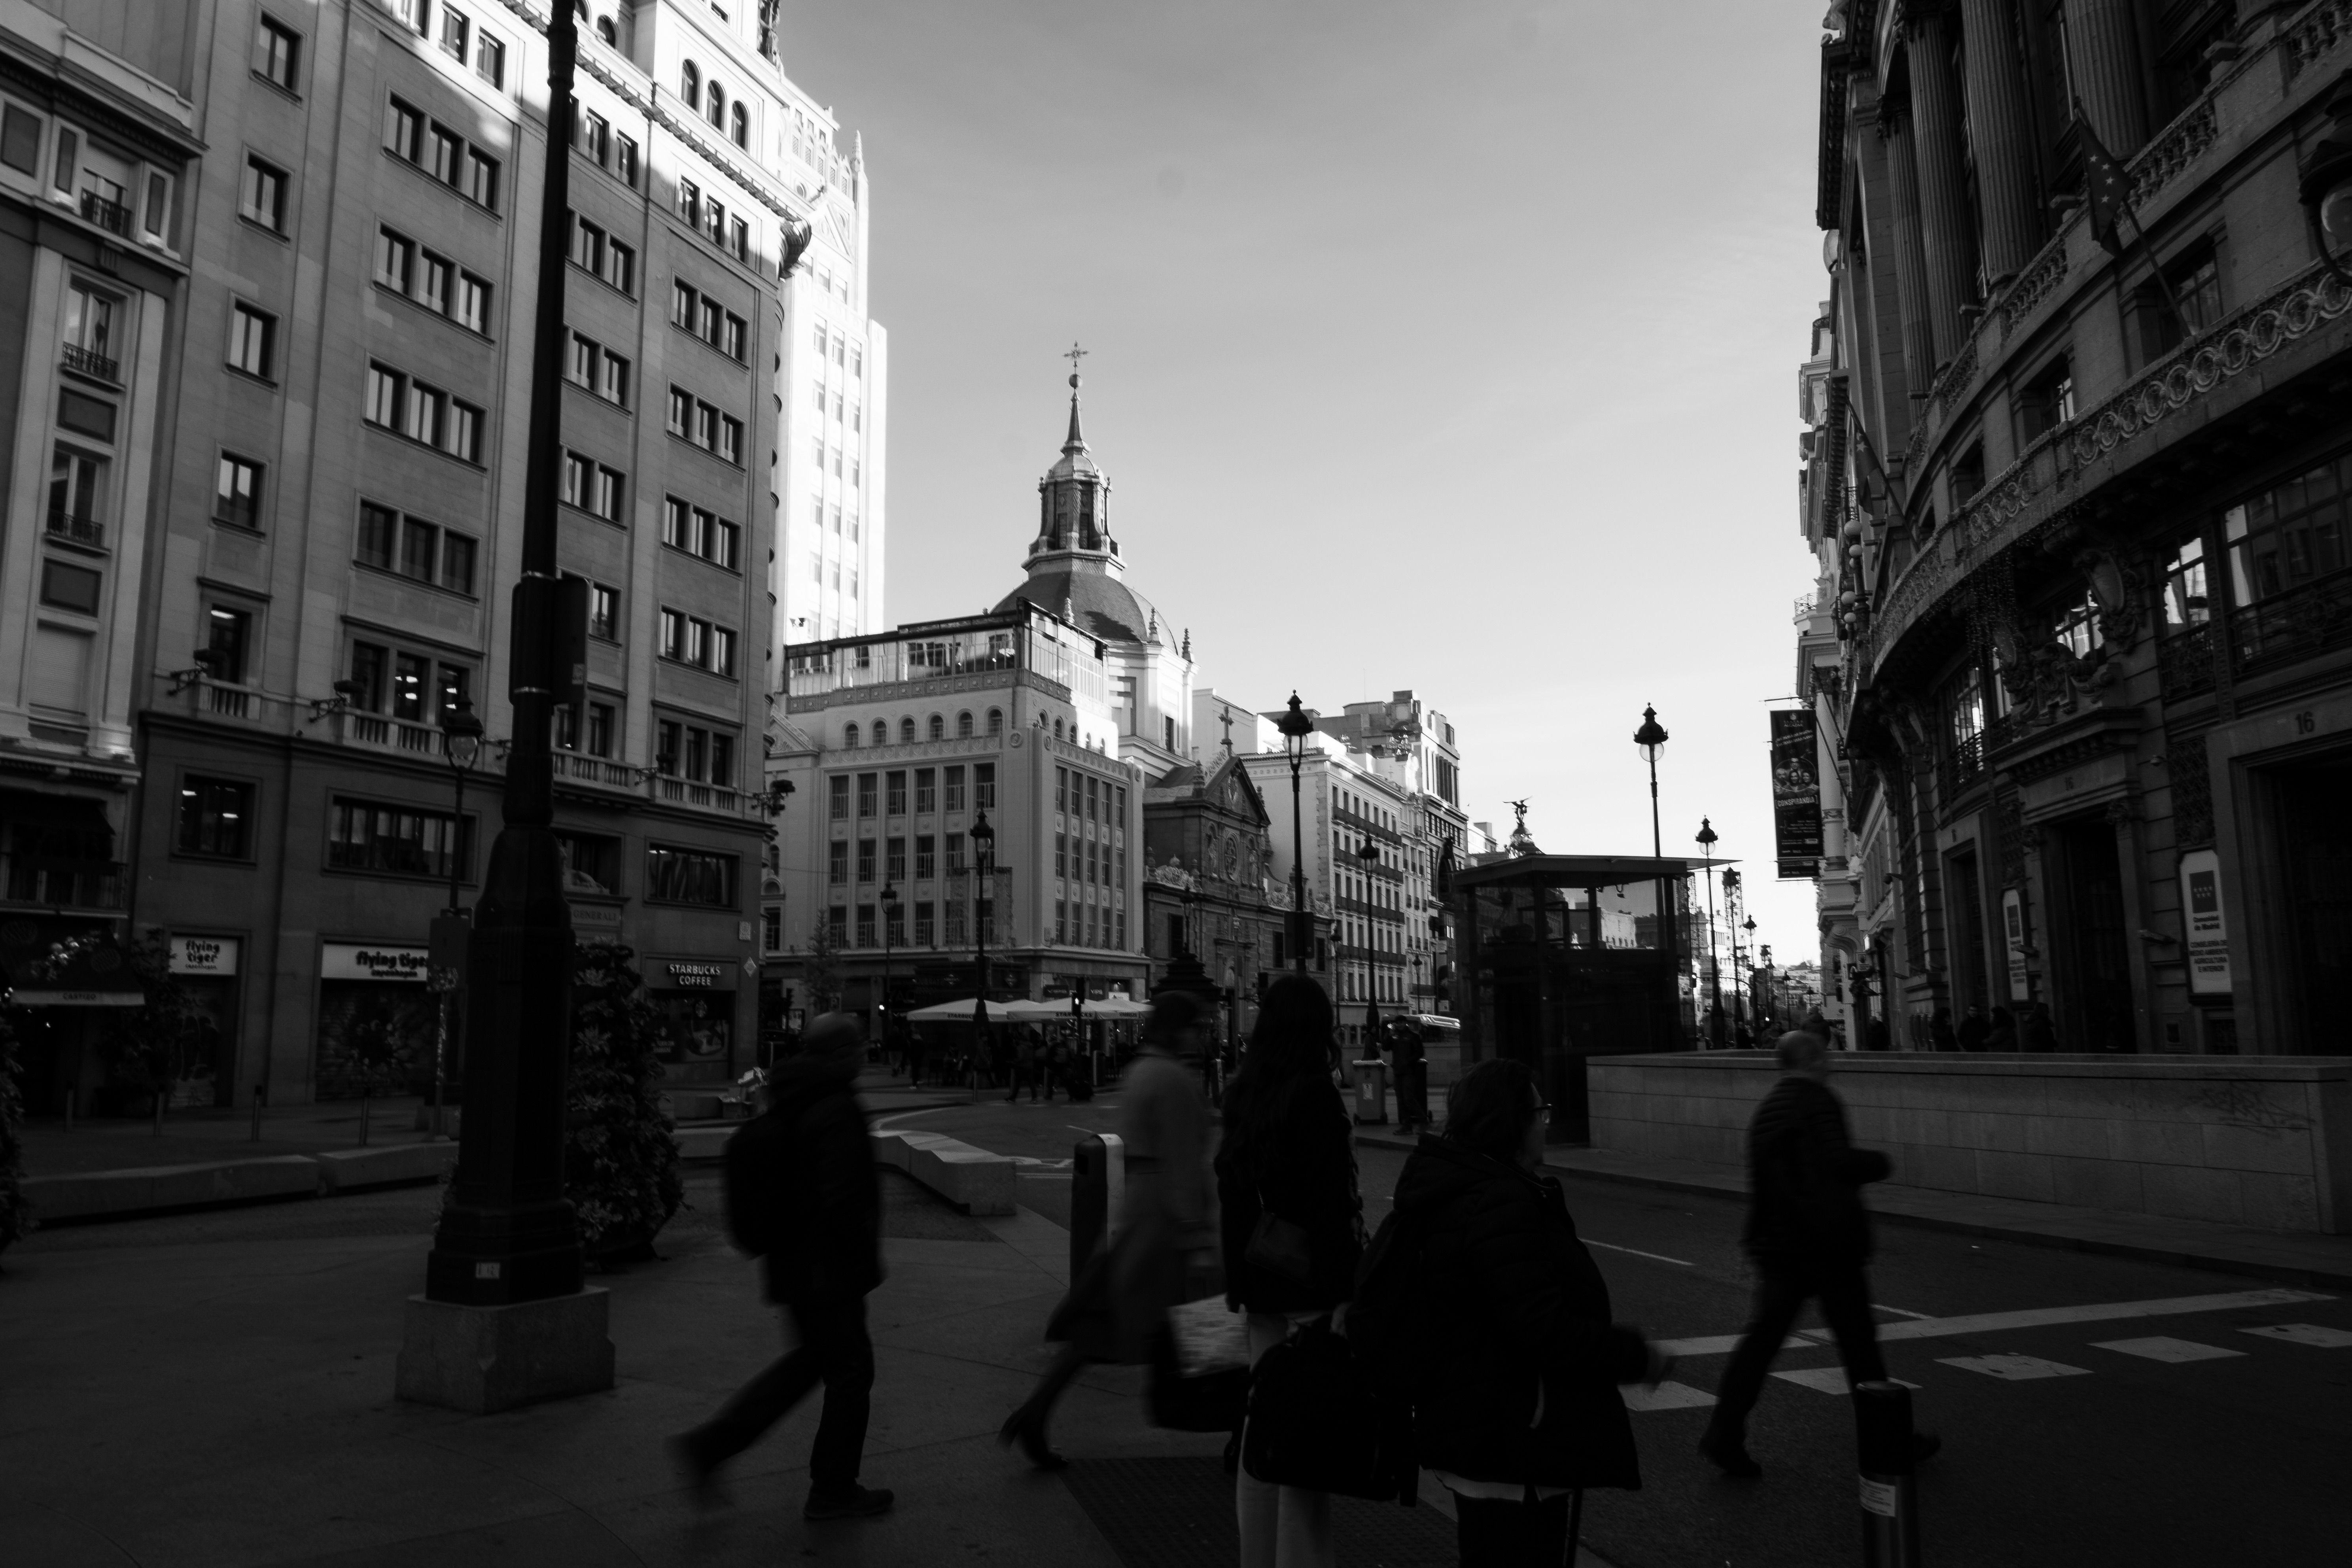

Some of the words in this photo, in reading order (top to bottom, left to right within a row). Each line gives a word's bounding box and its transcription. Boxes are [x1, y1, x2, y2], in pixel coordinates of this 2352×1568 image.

[2295, 711, 2314, 734] 16
[186, 939, 220, 954] flying
[187, 950, 217, 964] tiger
[357, 950, 396, 969] flying
[670, 964, 721, 976] STARBUCKS
[679, 975, 711, 986] COFFEE
